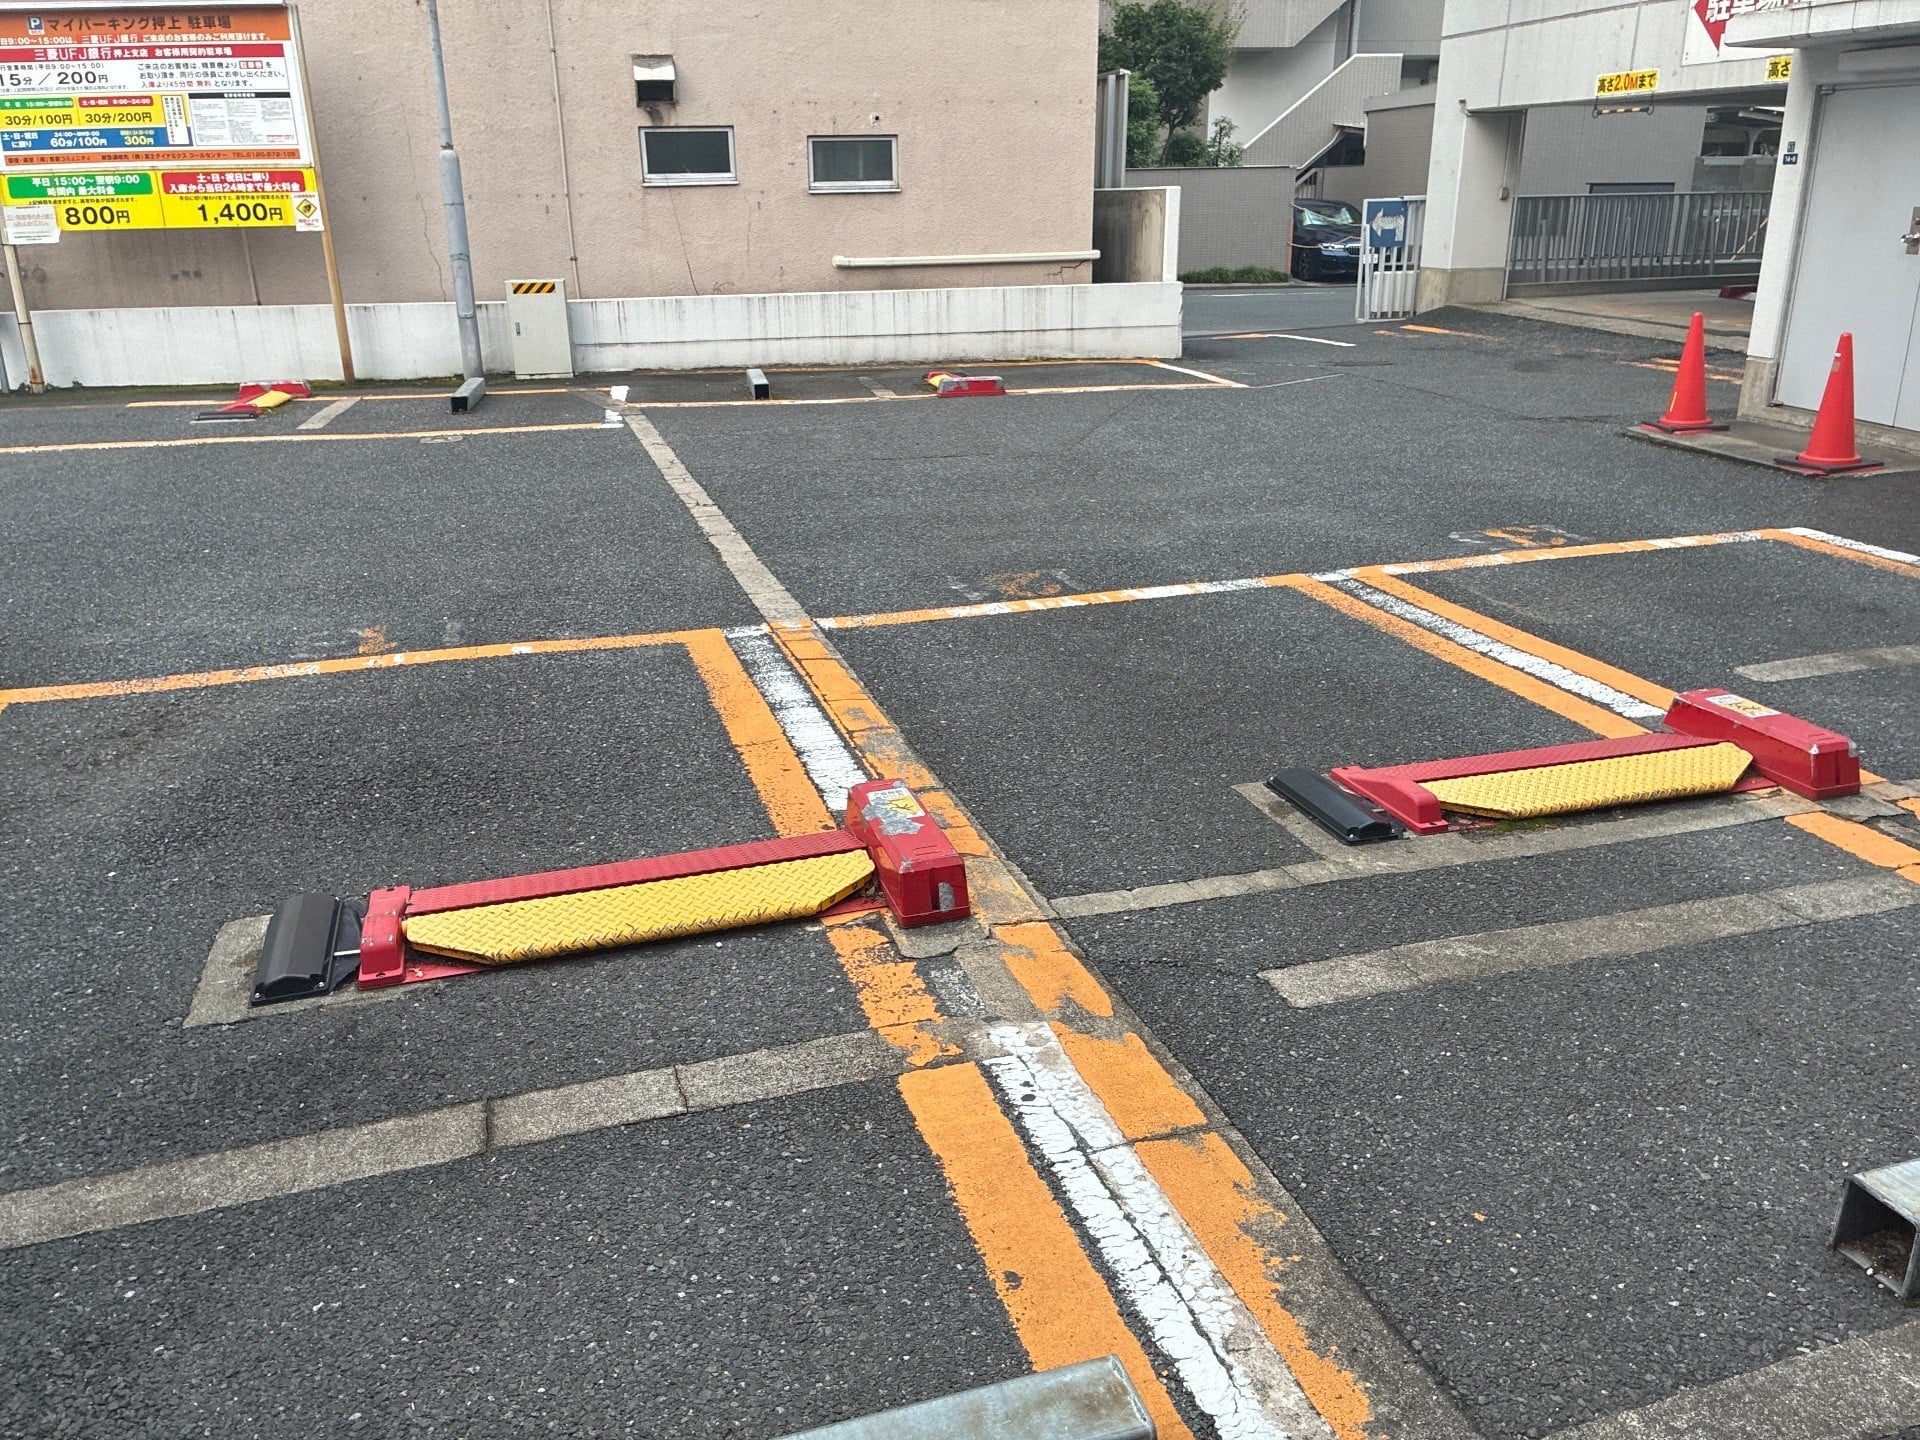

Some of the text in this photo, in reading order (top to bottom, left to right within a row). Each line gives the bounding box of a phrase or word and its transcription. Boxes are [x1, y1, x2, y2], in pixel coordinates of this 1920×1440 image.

[47, 15, 232, 31] マイパーキング押上 駐車場
[1767, 60, 1792, 78] 高さ
[1596, 71, 1657, 94] 高さ2.0Mまで
[5, 113, 73, 126] 30分/100円
[85, 112, 153, 124] 30分/200円
[50, 136, 108, 147] 60分/100円
[124, 136, 154, 146] 300円
[31, 177, 51, 187] 平日
[65, 206, 130, 225] 800円
[197, 203, 283, 224] 1,400円
